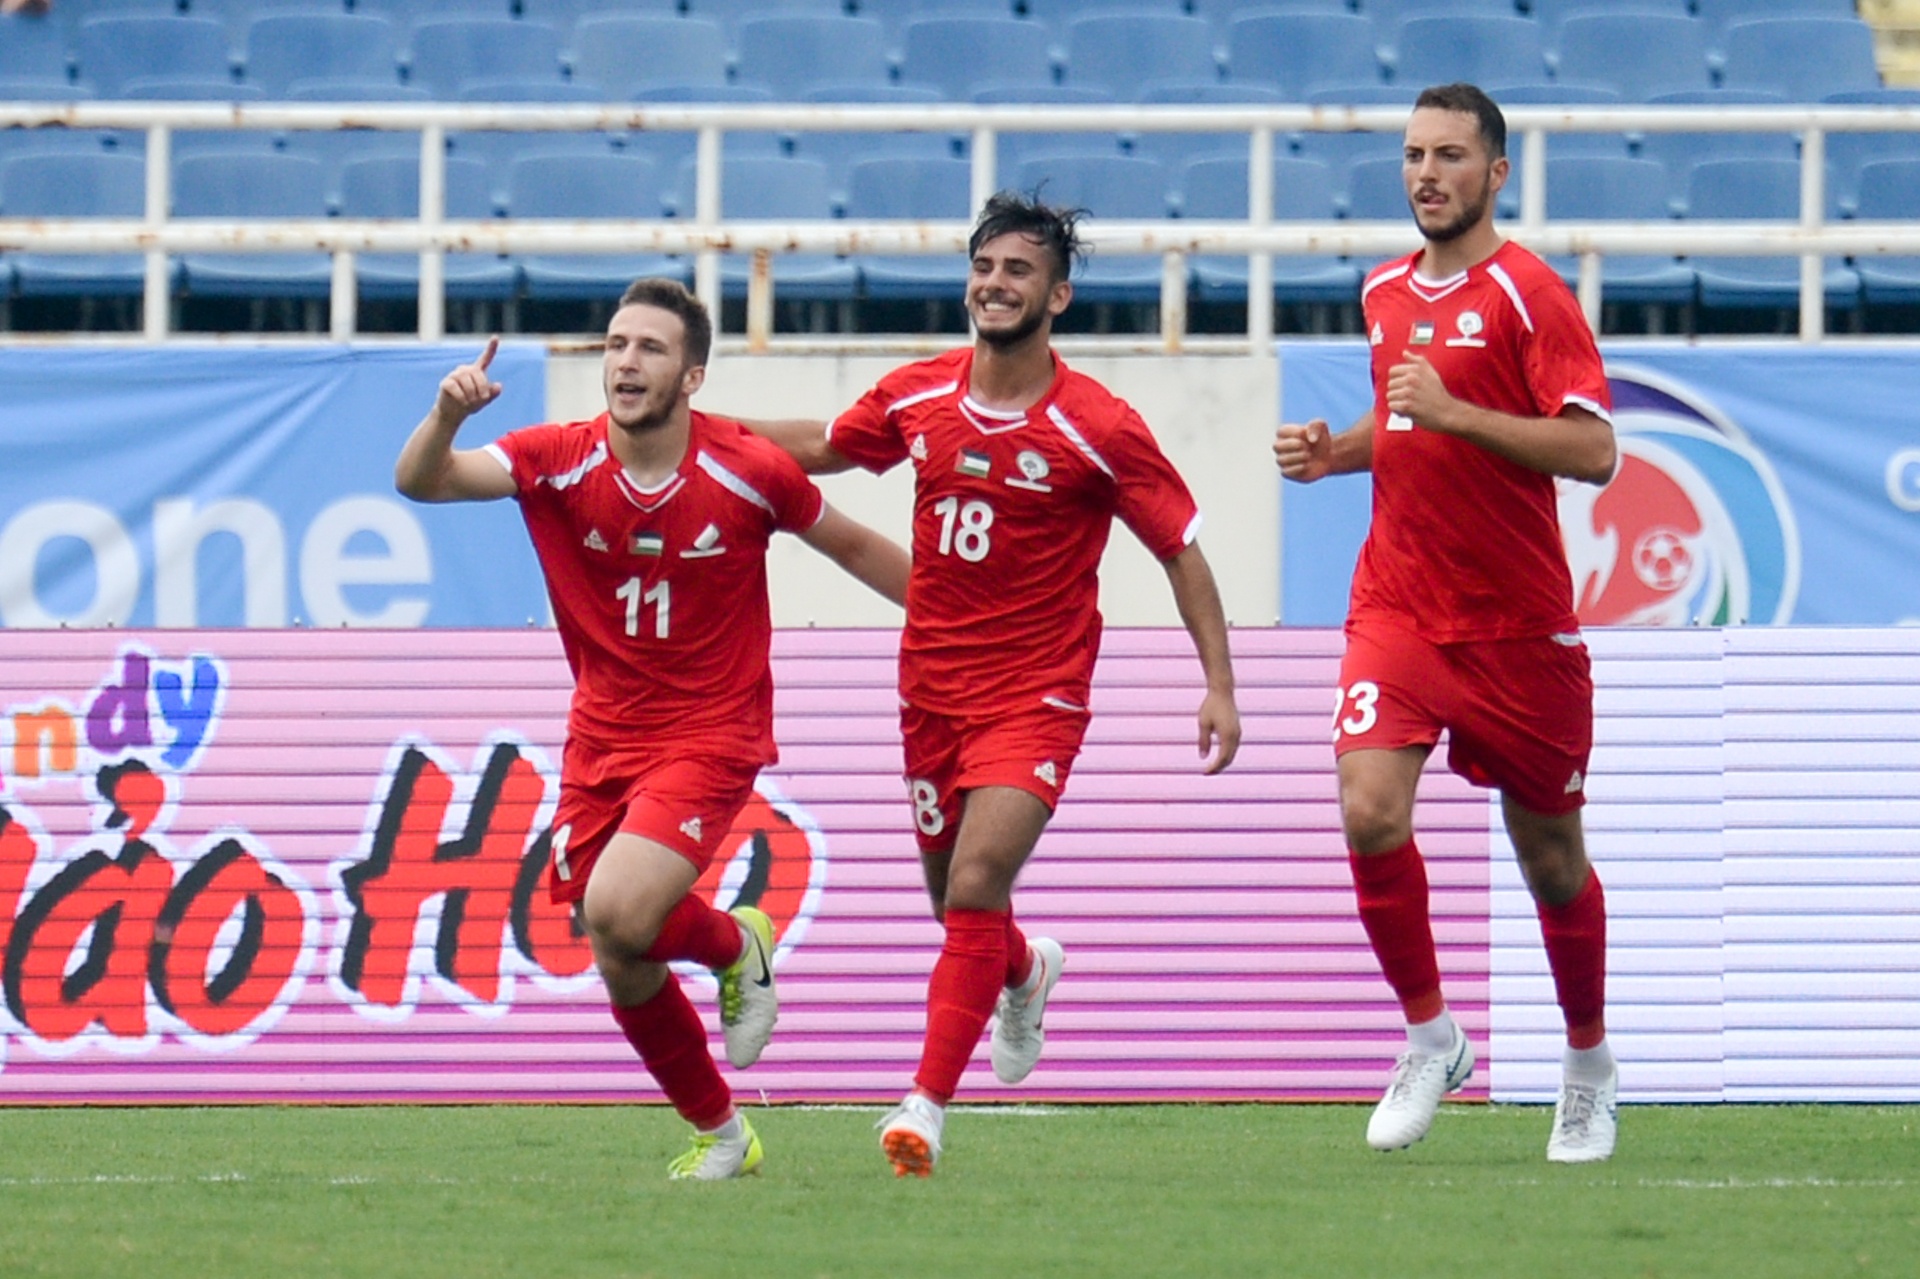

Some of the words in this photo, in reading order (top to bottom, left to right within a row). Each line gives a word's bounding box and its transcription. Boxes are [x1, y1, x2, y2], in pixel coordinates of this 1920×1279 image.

[0, 494, 433, 628] one
[934, 496, 994, 563] 18
[616, 576, 671, 639] 11
[905, 778, 945, 836] 8
[0, 758, 305, 1042] ảo
